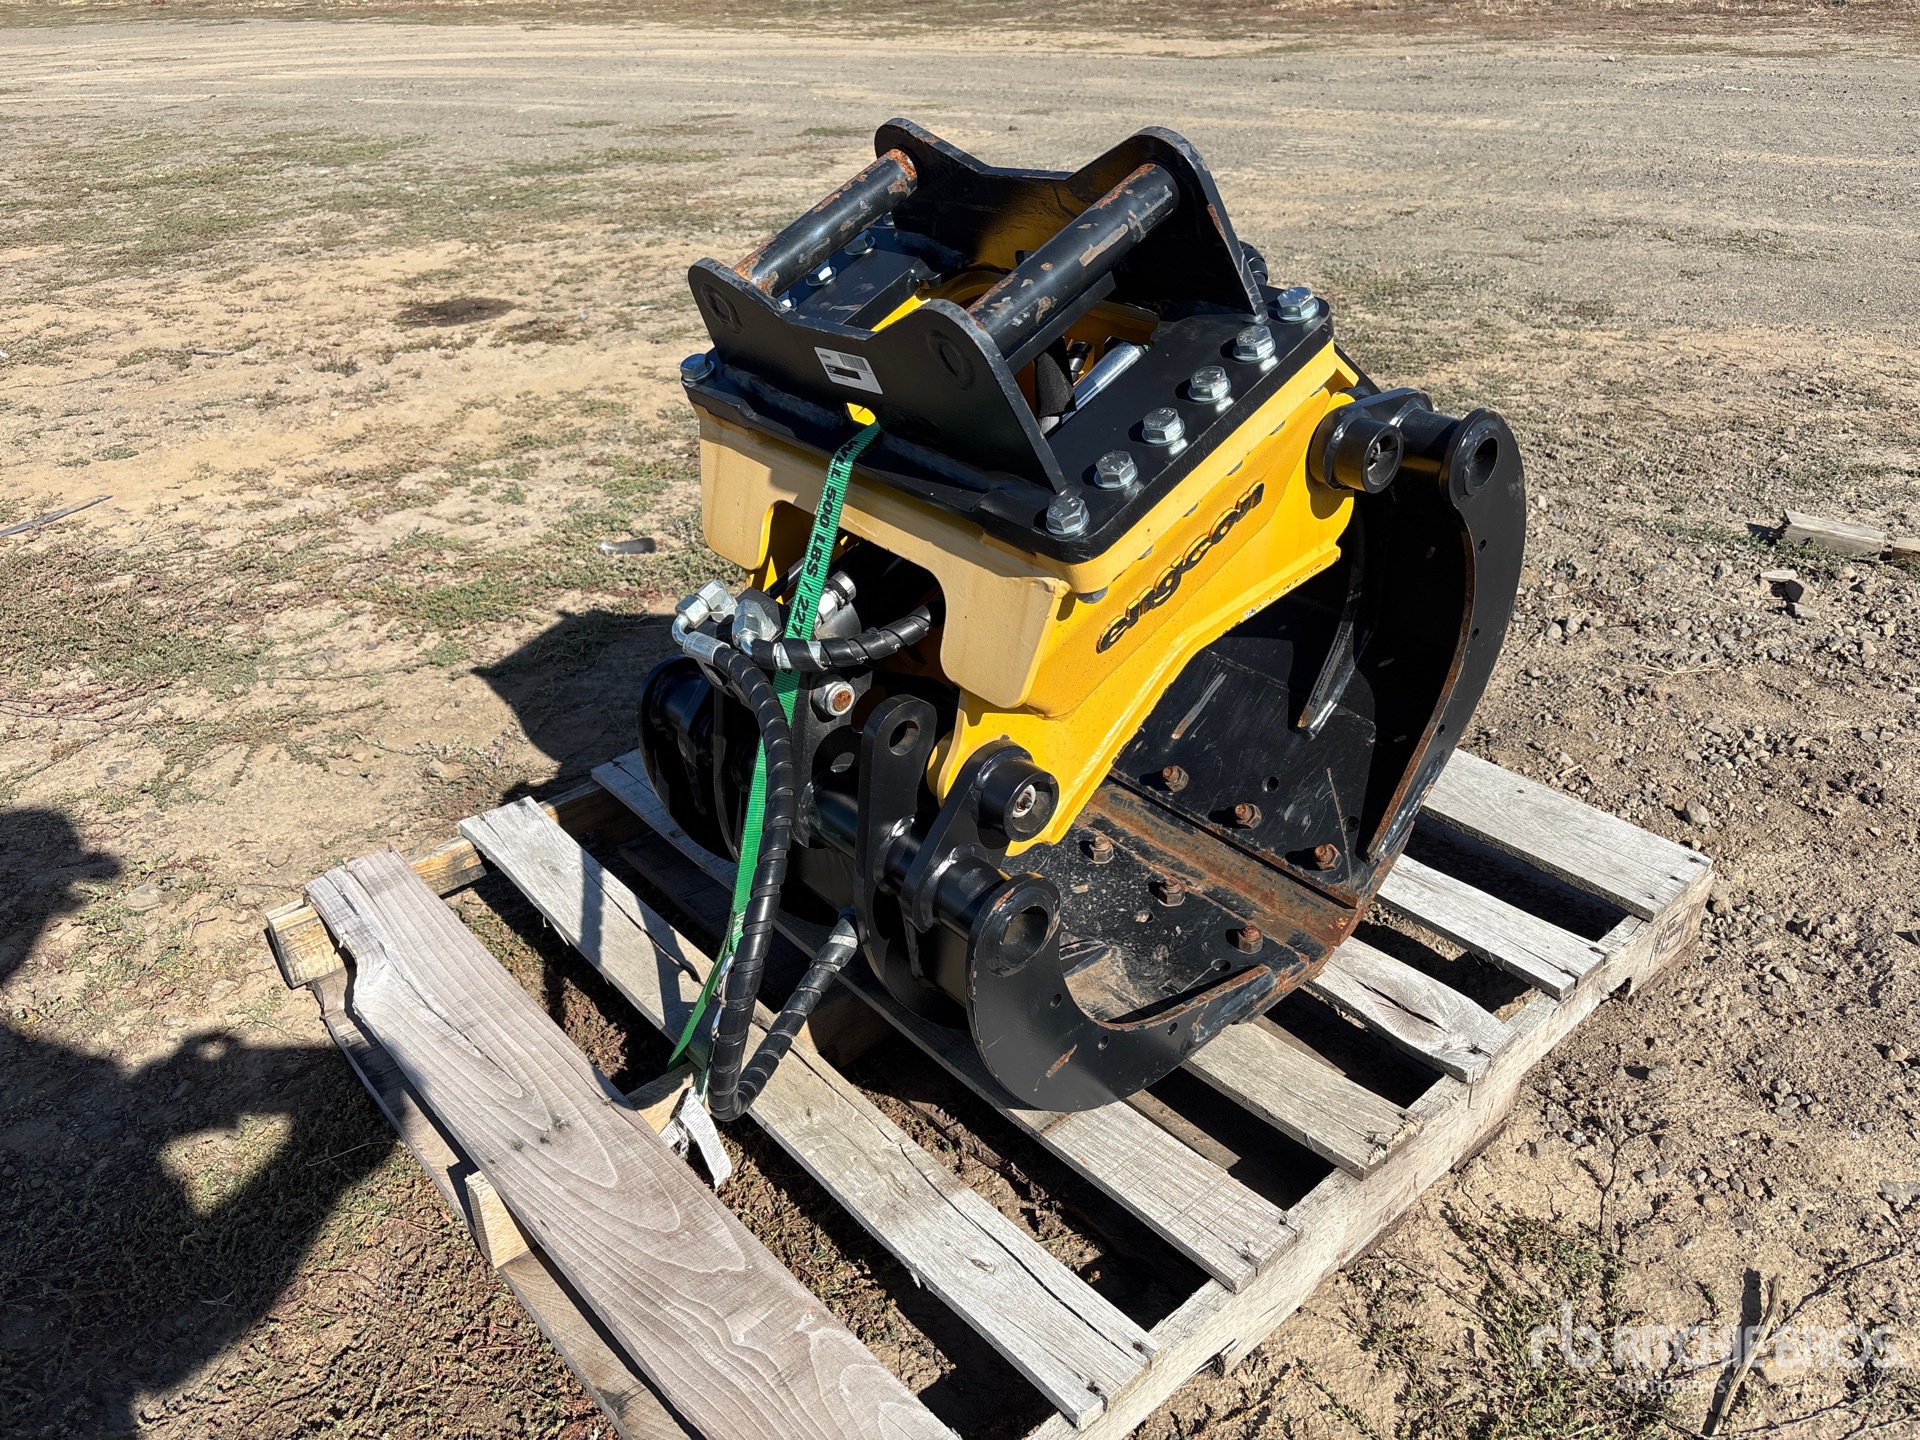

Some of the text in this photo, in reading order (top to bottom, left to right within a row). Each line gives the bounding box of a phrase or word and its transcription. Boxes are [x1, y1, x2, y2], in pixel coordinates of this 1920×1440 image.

[831, 440, 860, 479] WLL
[819, 486, 837, 529] 500
[806, 533, 825, 579] LBS
[1096, 481, 1265, 654] engcon
[788, 595, 809, 639] 227
